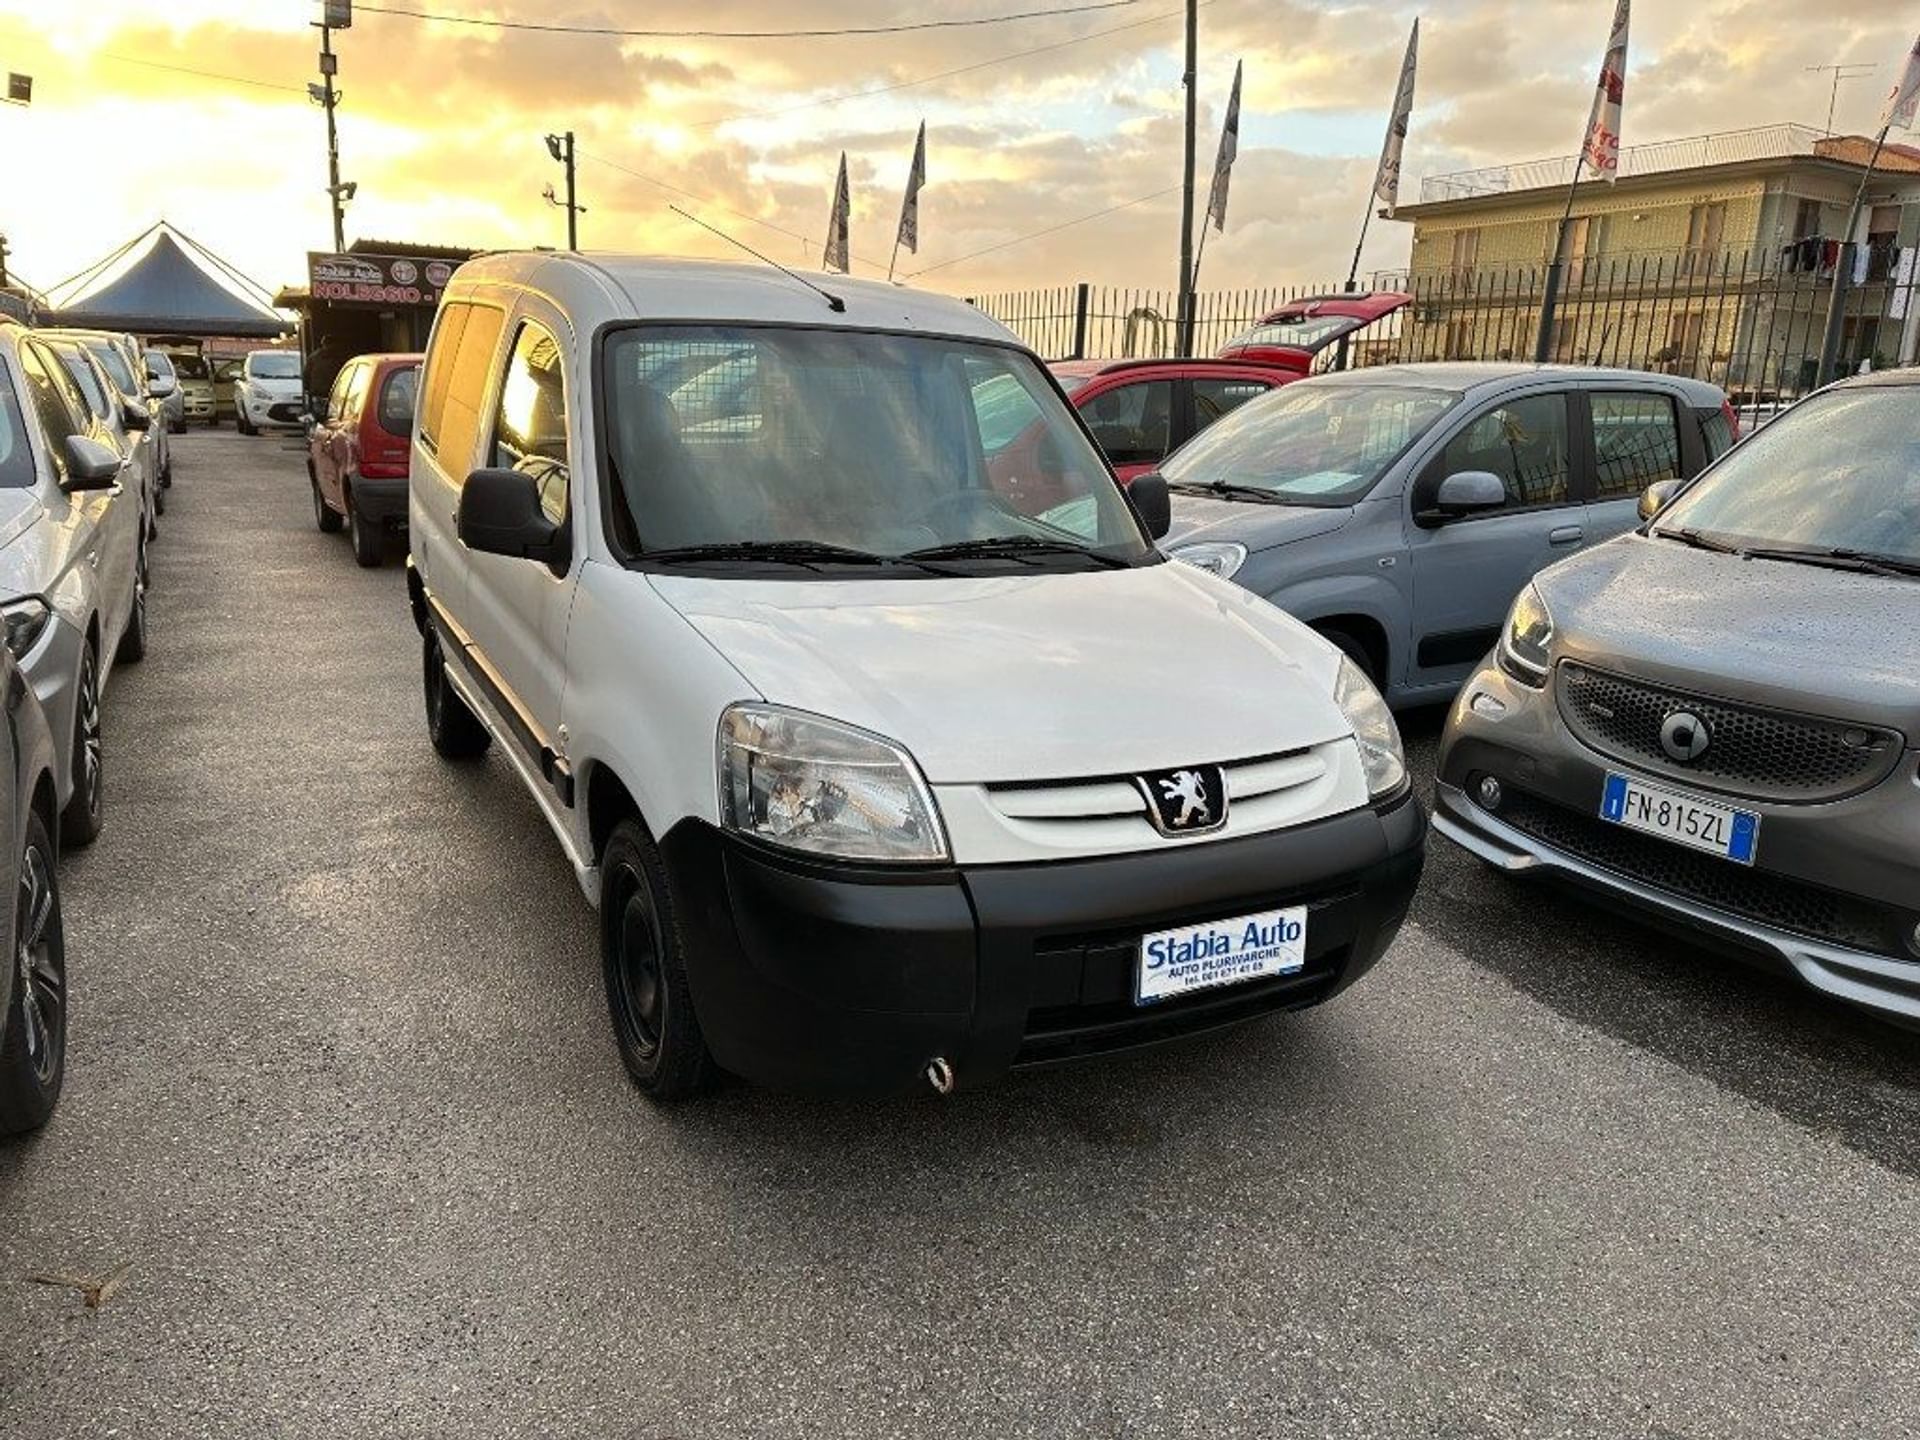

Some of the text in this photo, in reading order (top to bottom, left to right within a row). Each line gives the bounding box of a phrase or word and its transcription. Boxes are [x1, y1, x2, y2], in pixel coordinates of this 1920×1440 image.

[313, 282, 421, 304] NOLEGGIO
[1147, 917, 1301, 969] Stabia Auto
[1168, 947, 1280, 979] AUTO PLURIMARCHE
